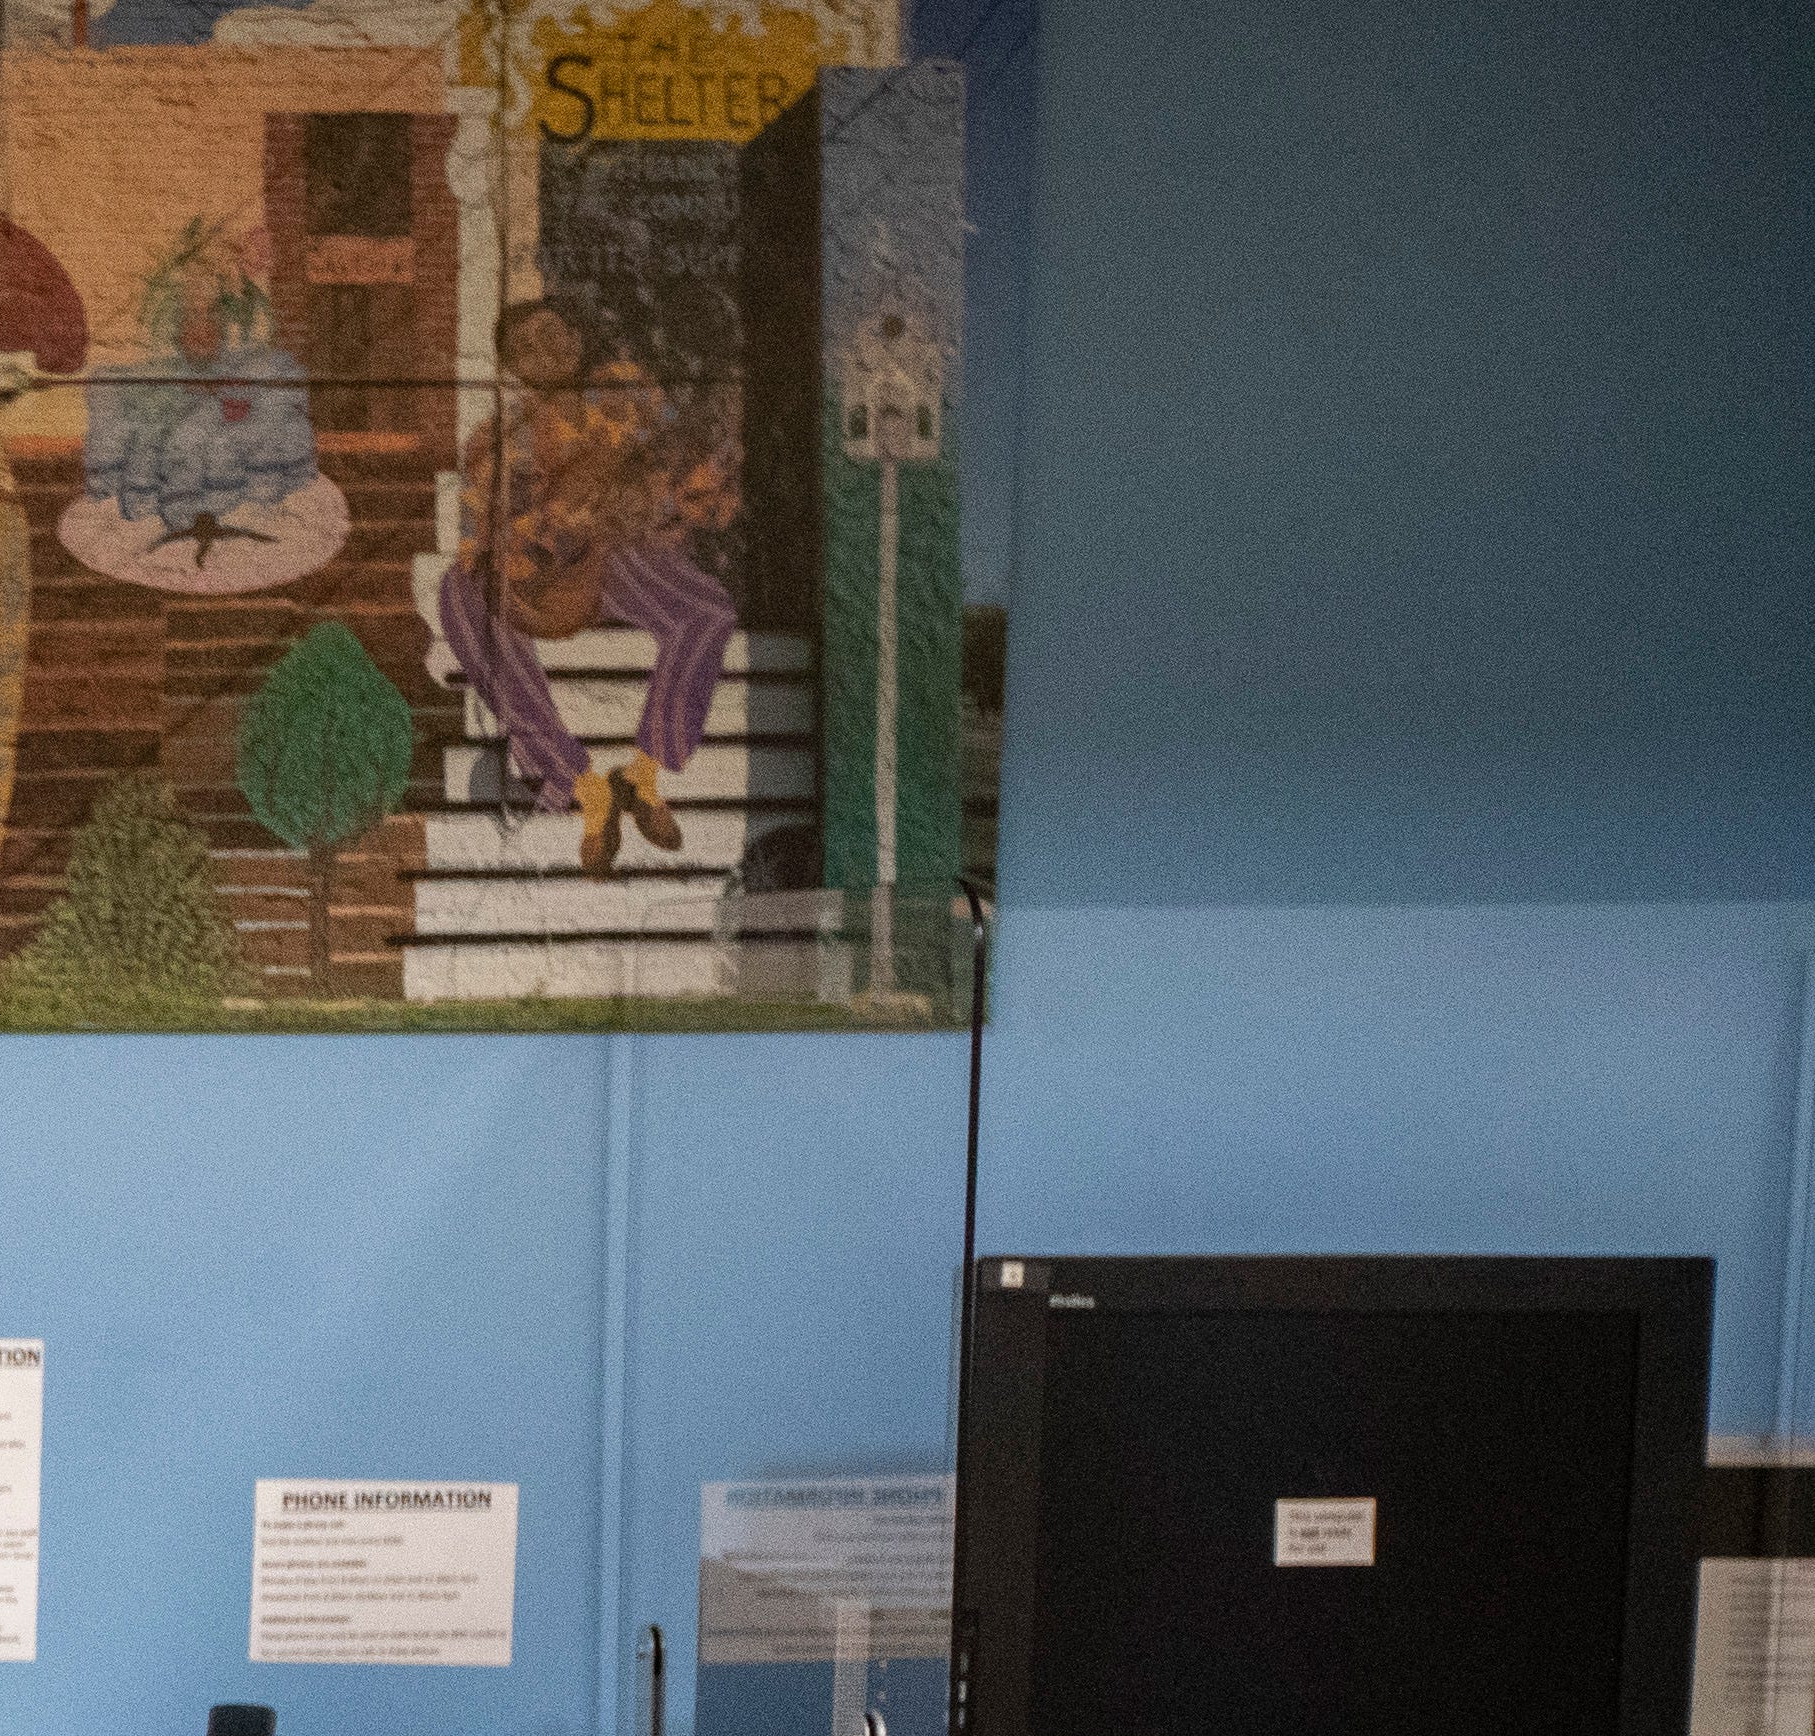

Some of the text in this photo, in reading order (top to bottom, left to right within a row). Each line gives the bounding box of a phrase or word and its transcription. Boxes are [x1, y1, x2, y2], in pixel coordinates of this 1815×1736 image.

[539, 53, 788, 143] SHELTER
[281, 1489, 493, 1511] PHONE INFORMATION
